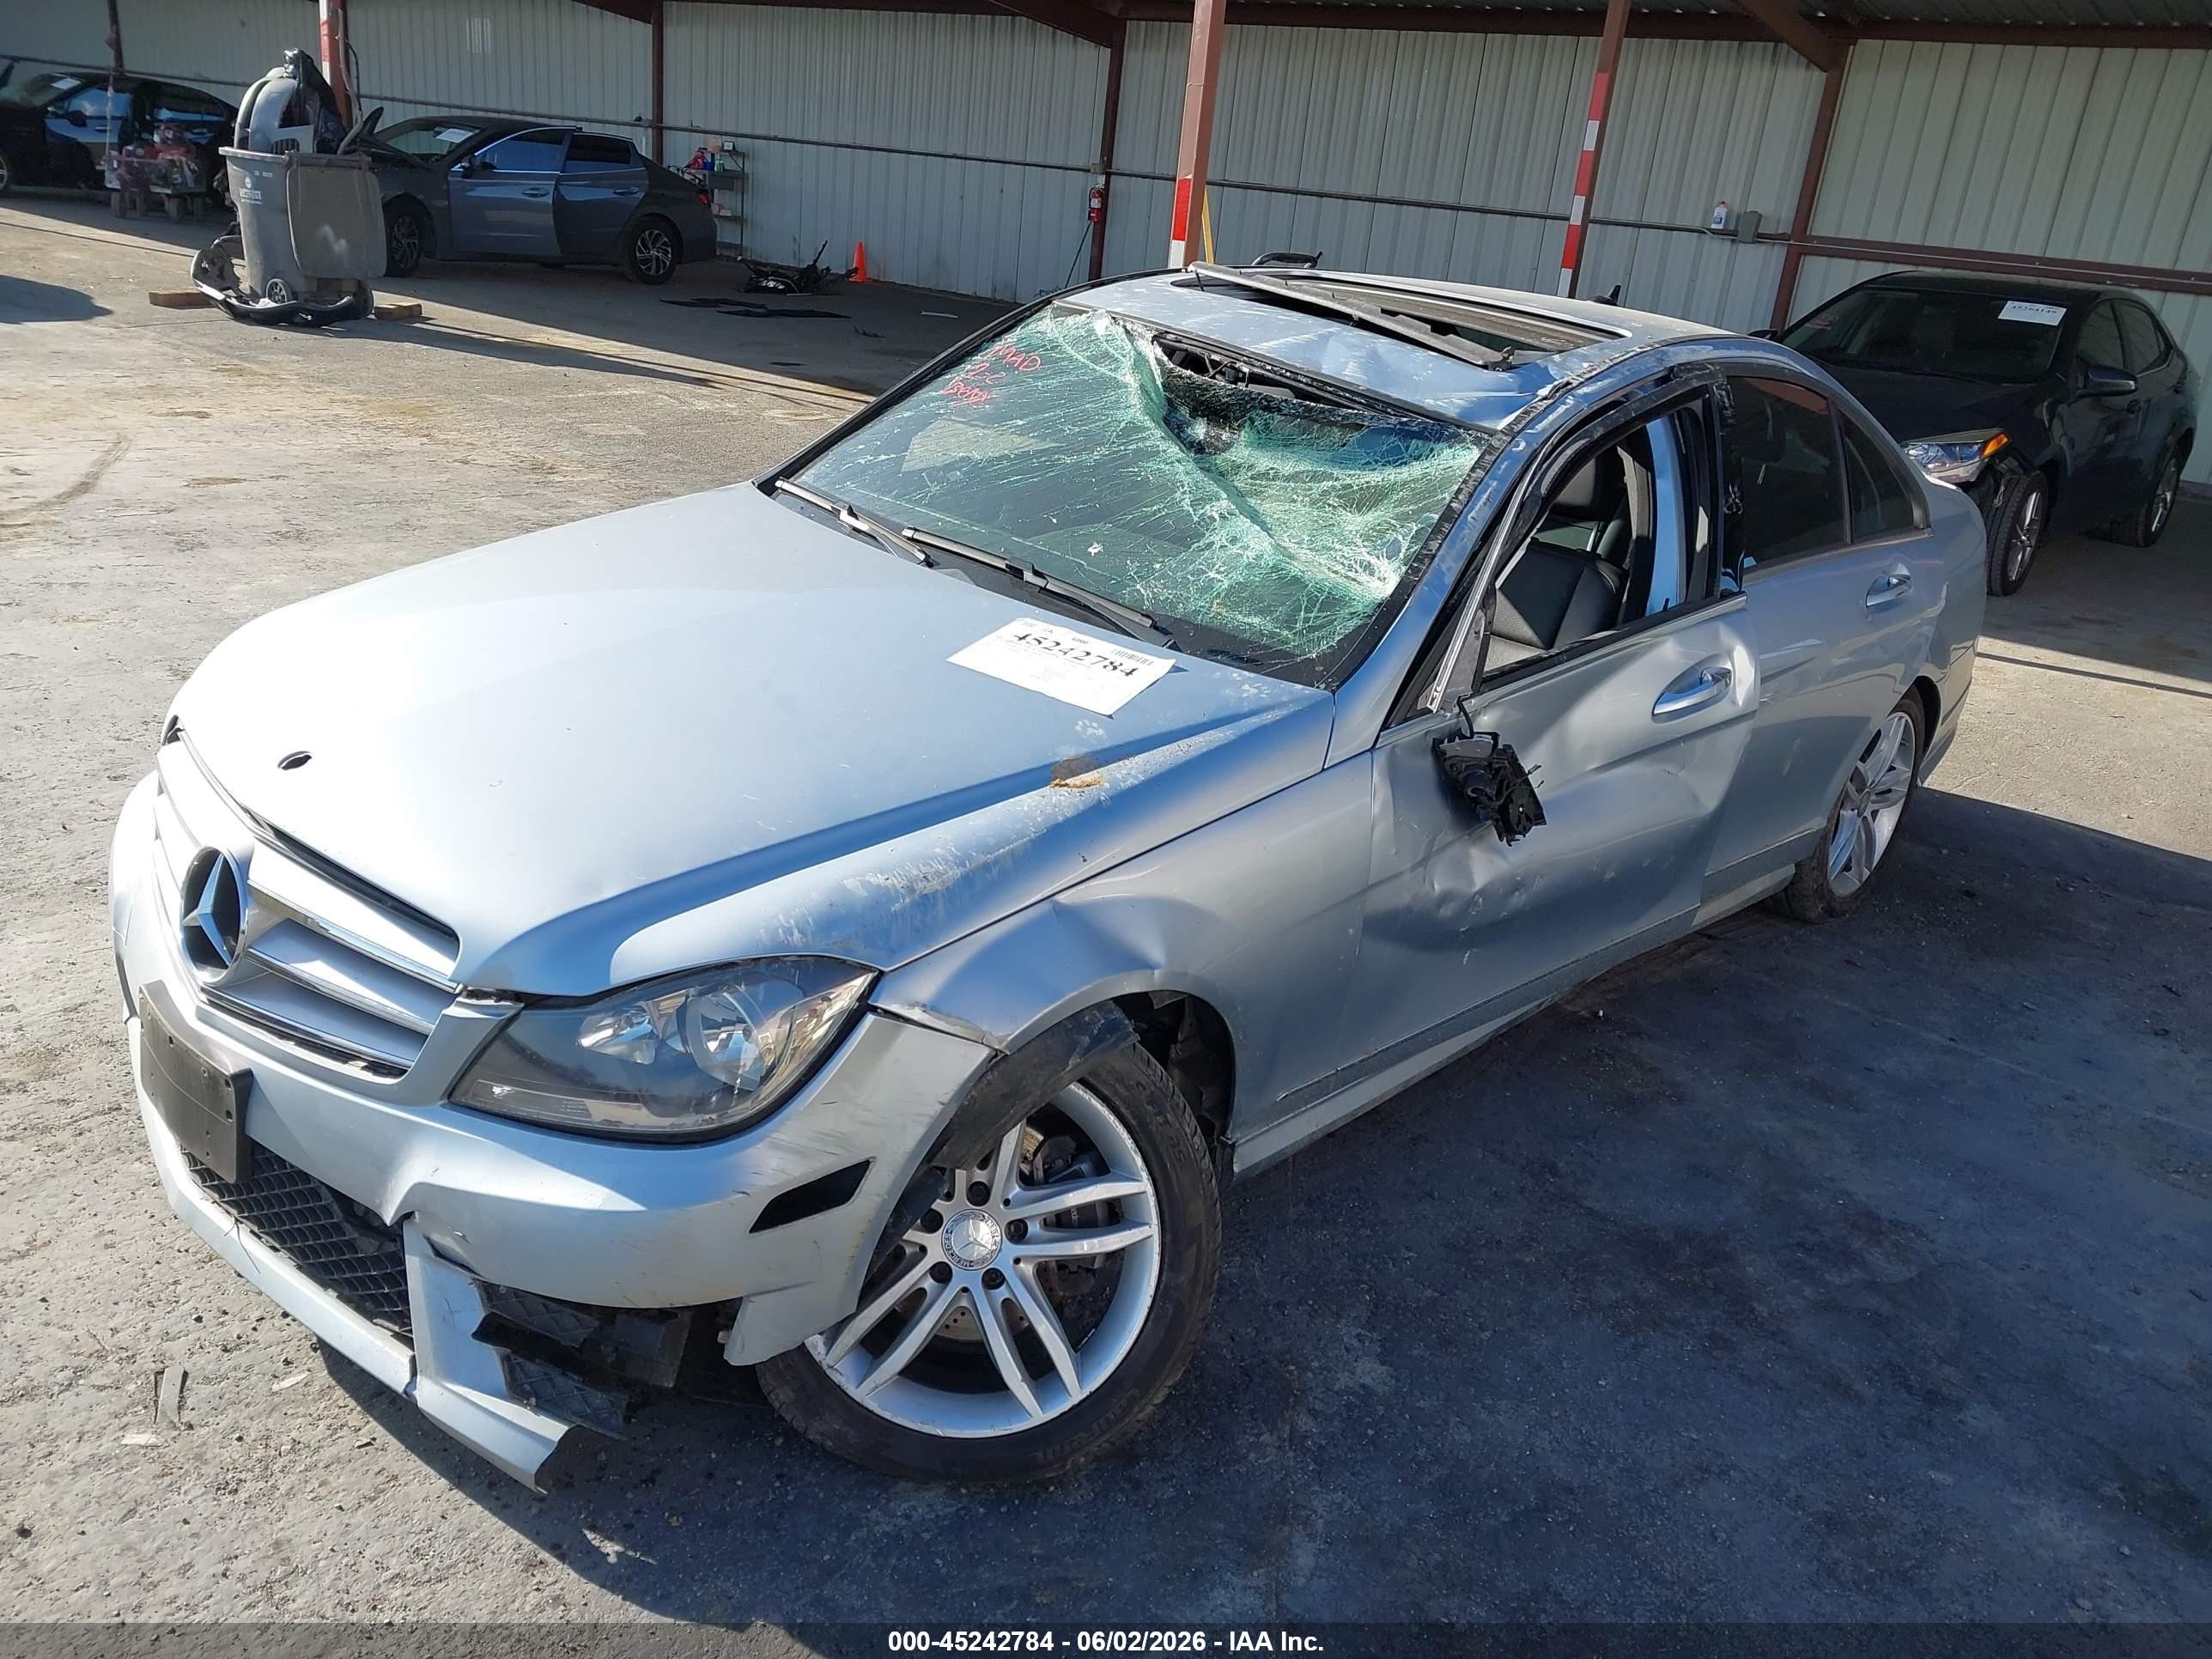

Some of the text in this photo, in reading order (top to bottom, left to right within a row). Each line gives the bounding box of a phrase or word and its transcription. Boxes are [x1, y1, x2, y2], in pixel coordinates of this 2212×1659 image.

[1013, 633, 1140, 677] 45242784
[943, 1214, 1000, 1267] MERCEDES BENZ
